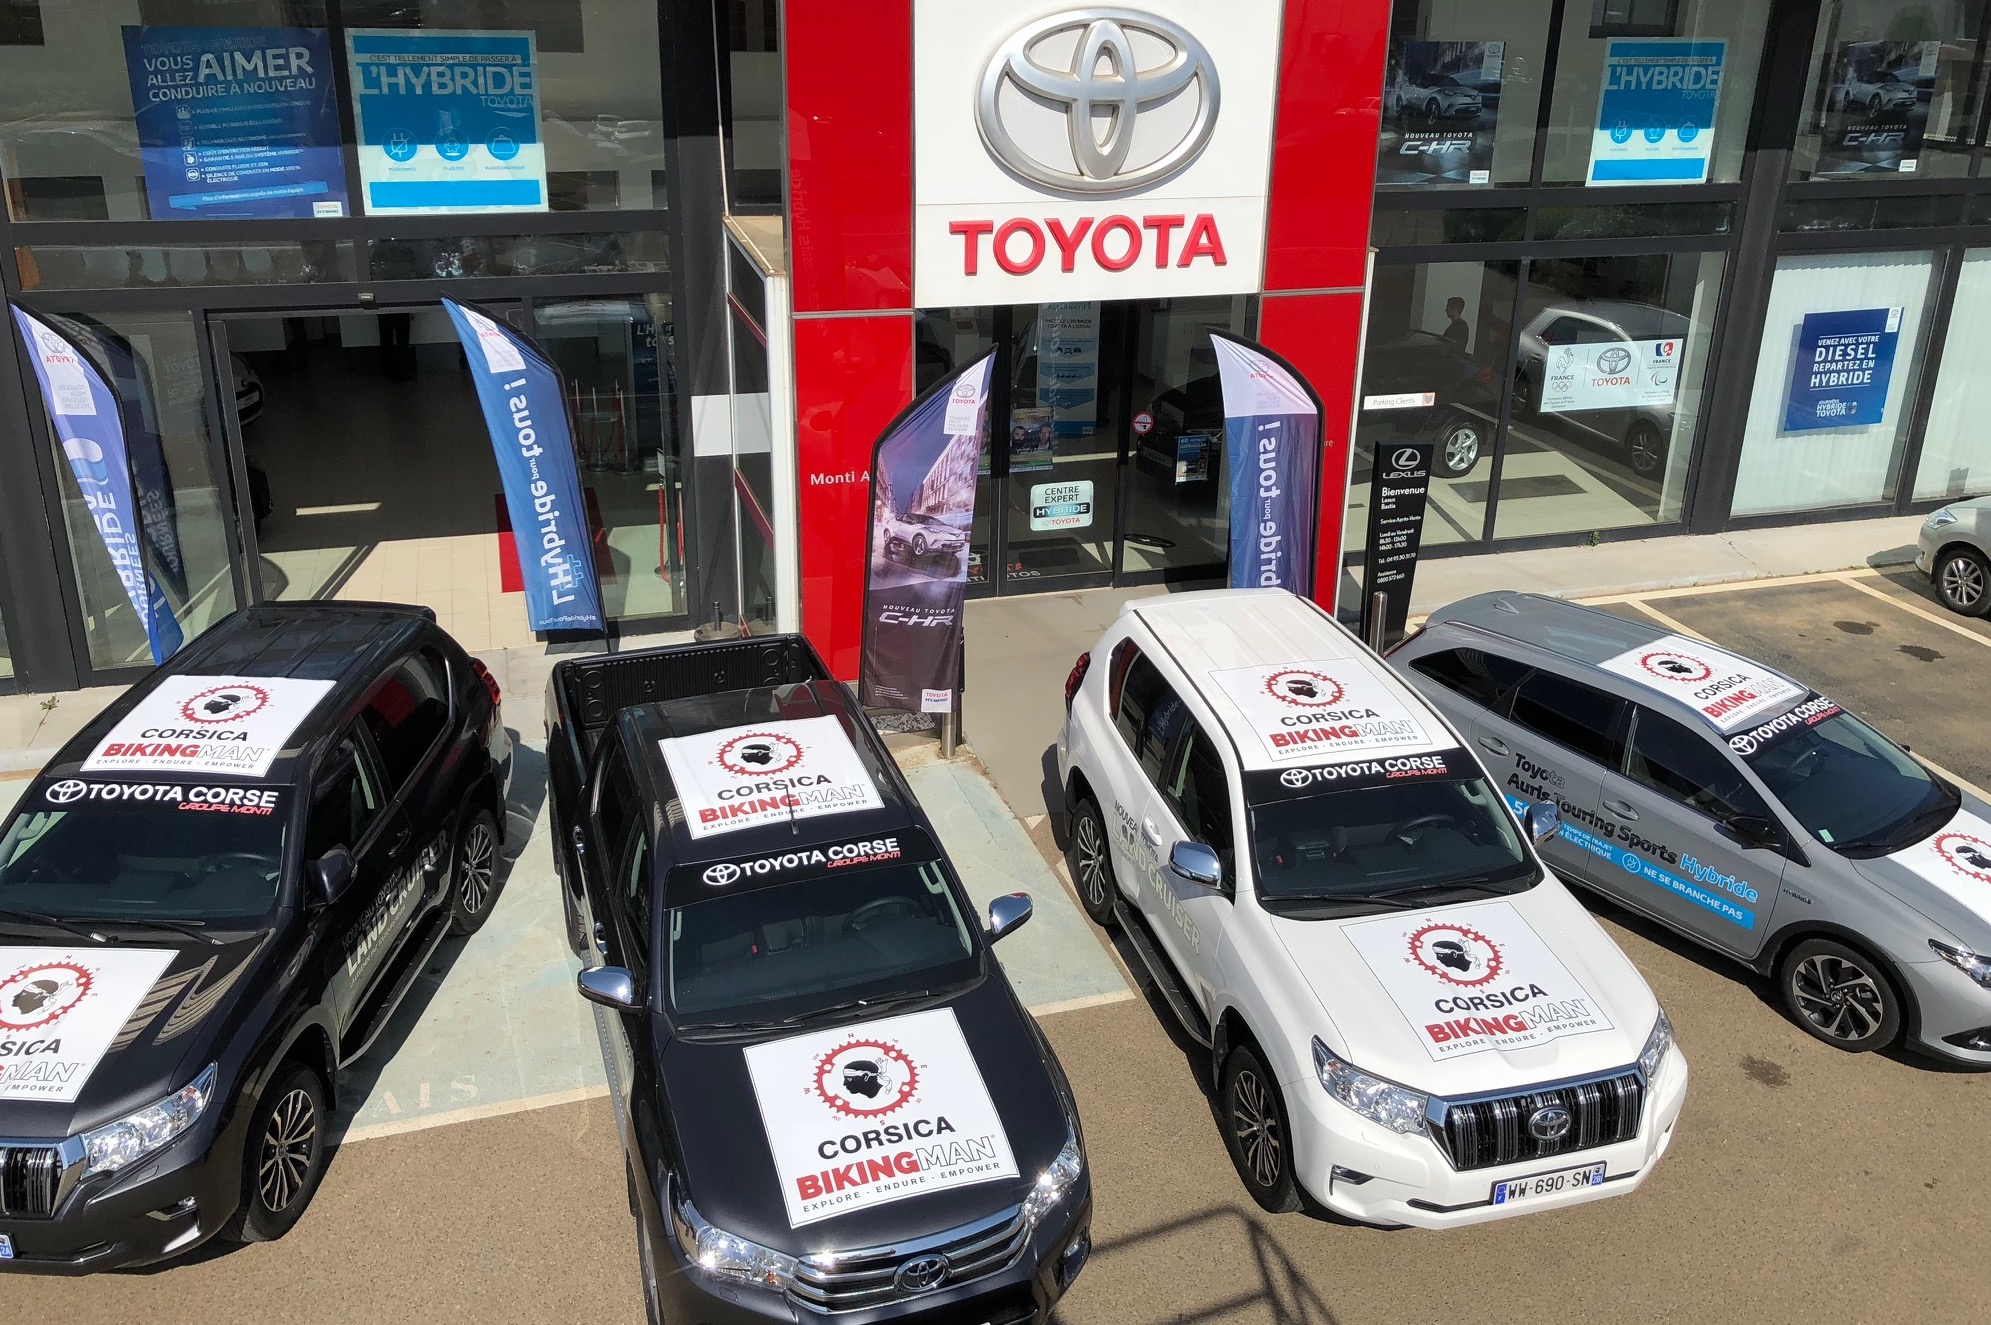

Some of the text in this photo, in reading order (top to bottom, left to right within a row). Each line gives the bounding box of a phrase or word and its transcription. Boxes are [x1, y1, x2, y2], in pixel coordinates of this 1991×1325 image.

[143, 55, 194, 72] VOUS
[197, 46, 314, 83] AIMER
[394, 55, 438, 63] TELLEMENT
[439, 55, 467, 63] SIMPLE
[147, 72, 195, 87] ALLEZ
[358, 65, 535, 95] L'HYBRIDE
[1603, 65, 1723, 90] L'HYBRIDE
[149, 77, 316, 101] CONDUIRE À NOUVEAU
[1681, 90, 1716, 100] TOYOTA
[480, 95, 534, 108] TOYOTA
[1399, 140, 1472, 155] C-HR
[1841, 131, 1906, 146] C-HR
[948, 212, 1229, 278] TOYOTA
[1818, 338, 1839, 346] VENEZ
[1858, 335, 1880, 343] VOTRE
[1814, 343, 1877, 362] DIESEL
[1812, 359, 1875, 372] REPARTEZ EN
[1591, 376, 1631, 387] TOYOTA
[1809, 370, 1873, 387] HYBRIDE
[1372, 397, 1415, 407] Parking Clients
[1816, 402, 1847, 410] HYBRIDE
[1816, 409, 1846, 418] TOYOTA
[810, 471, 855, 486] Monti
[1382, 470, 1427, 479] LEXUS
[1044, 486, 1080, 495] CENTRE
[1044, 494, 1079, 504] EXPERT
[1381, 486, 1425, 497] Bienvenue
[1036, 503, 1087, 517] HYBRIDE
[1050, 517, 1081, 525] TOYOTA
[882, 603, 922, 613] NOUVEAU
[878, 612, 954, 627] C-HR
[1694, 673, 1752, 700] CORSICA
[1280, 708, 1381, 727] CORSICA
[1721, 709, 1744, 724] EXPLORE
[1749, 696, 1835, 743] TOYOTA CORSE
[140, 728, 248, 742] CORSICA
[1269, 719, 1414, 748] BIKINGMAN
[101, 743, 265, 762] BIKINGMAN
[1278, 734, 1419, 755] EXPLORE ENDURE EMPOWER
[204, 760, 255, 770] EMPOWER
[1311, 755, 1446, 782] TOYOTA CORSE
[1386, 767, 1448, 779] GROUPE MONTI
[1514, 752, 1566, 790] Toyota
[89, 784, 280, 808] TOYOTA CORSE
[717, 773, 833, 801] CORSICA
[177, 801, 273, 816] GROUPE MONTI
[698, 784, 865, 824] BIKINGMAN
[703, 799, 868, 831] EXPLORE ENDURE EMPOWER
[1507, 772, 1759, 903] Auris Touring Sports Hybride
[1562, 823, 1613, 852] TEMPS DE TRAJET
[1564, 832, 1612, 860] ÉLECTRIQUE
[740, 838, 901, 877] TOYOTA CORSE
[827, 851, 901, 869] GROUPE MONTI
[1643, 866, 1744, 921] NE SE BRANCHE PAS
[1148, 861, 1200, 954] CRUISER
[1434, 983, 1549, 1014] CORSICA
[1424, 998, 1591, 1044] BIKINGMAN
[1438, 1019, 1597, 1053] EXPLORE ENDURE EMPOWER
[0, 1038, 61, 1057] SICA
[817, 1115, 956, 1160] CORSICA
[796, 1135, 996, 1201] BIKINGMAN
[803, 1162, 1001, 1213] EXPLORE ENDURE EMPOWER
[1, 1247, 11, 1255] 2A
